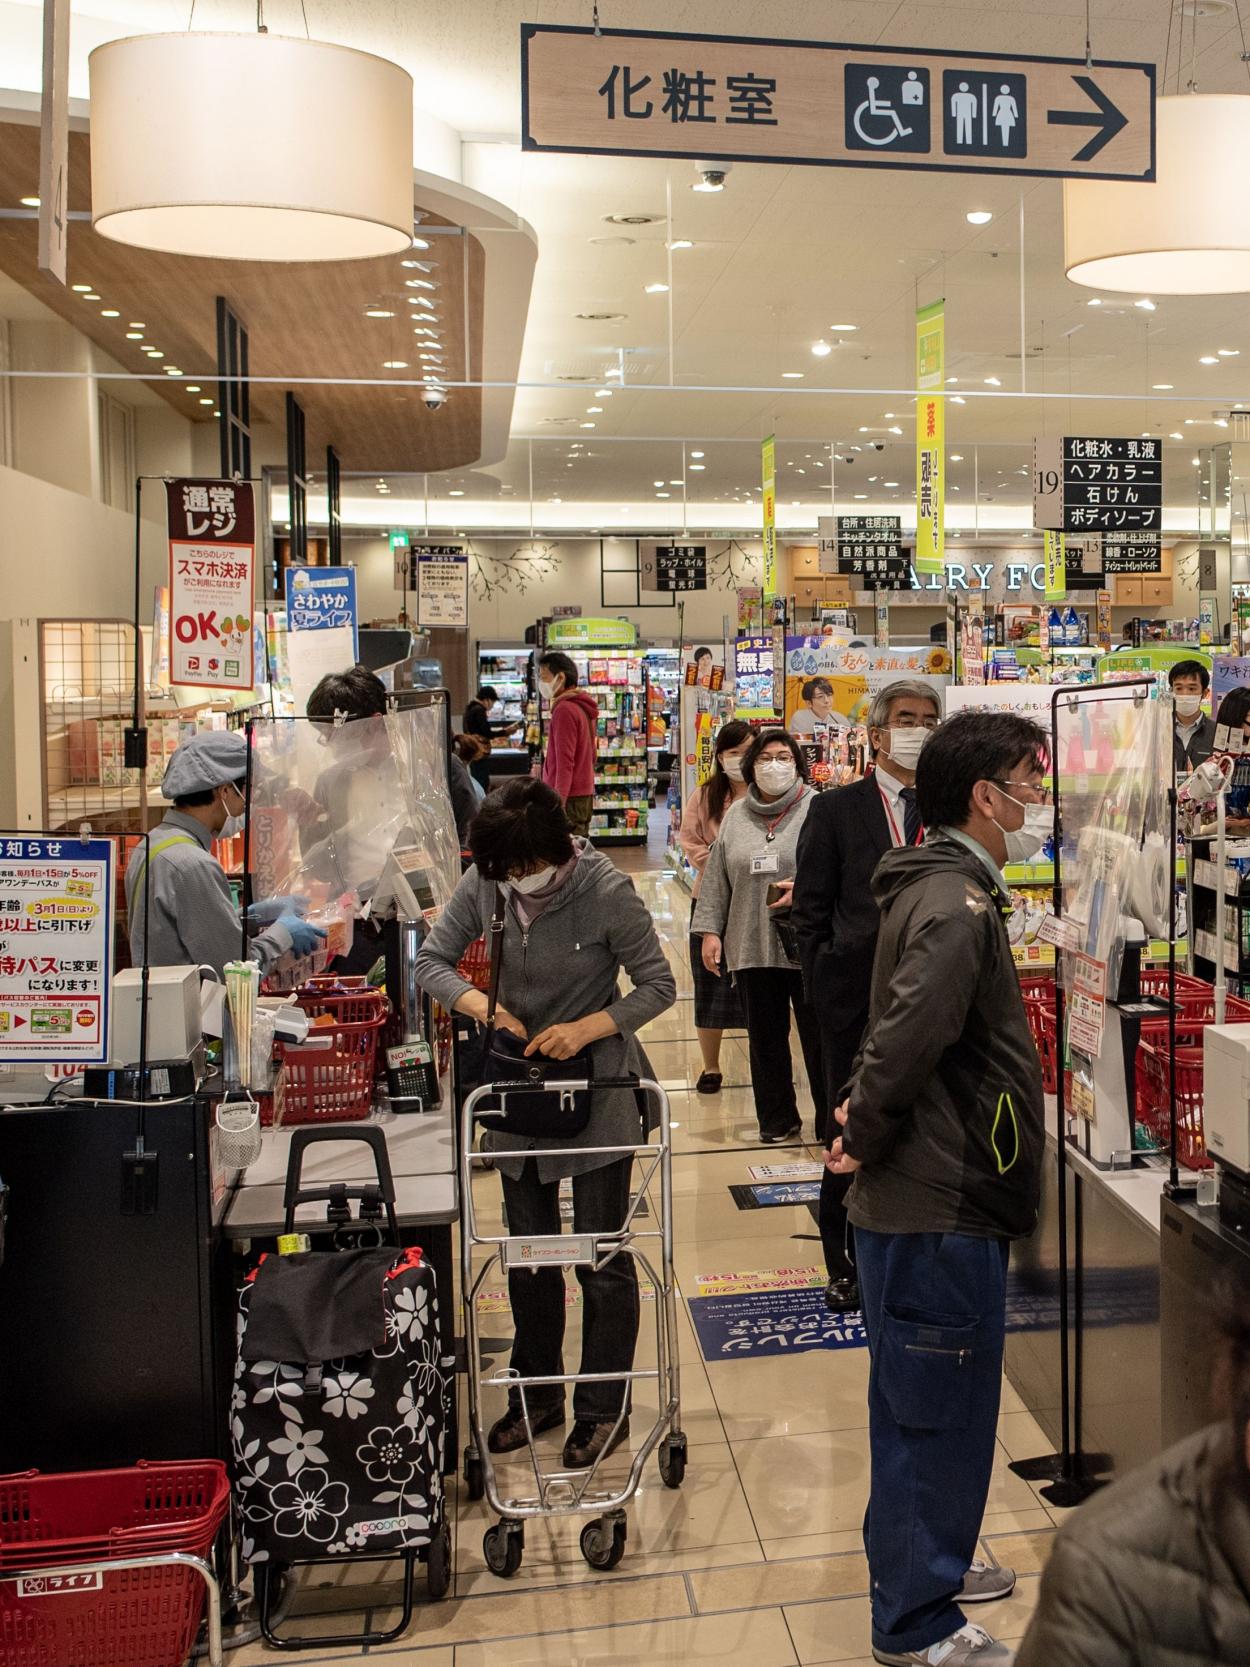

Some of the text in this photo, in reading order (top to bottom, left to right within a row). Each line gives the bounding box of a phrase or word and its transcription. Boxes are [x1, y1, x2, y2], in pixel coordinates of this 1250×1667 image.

[598, 65, 779, 126] 化粧室
[1071, 440, 1155, 460] 化粧水・乳液
[1037, 470, 1059, 495] 19
[1070, 464, 1154, 482] ヘアカラー
[183, 486, 236, 513] 通常
[1087, 486, 1139, 504] 石けん
[186, 511, 236, 537] レジ
[1071, 508, 1155, 526] ボディソープ
[842, 546, 898, 557] 自然派商品
[178, 560, 248, 580] スマホ決済
[645, 562, 653, 574] 9
[294, 593, 349, 609] さわやか
[175, 610, 220, 643] OK
[291, 610, 352, 629] 夏ライフ
[49, 1575, 92, 1589] ライフ
